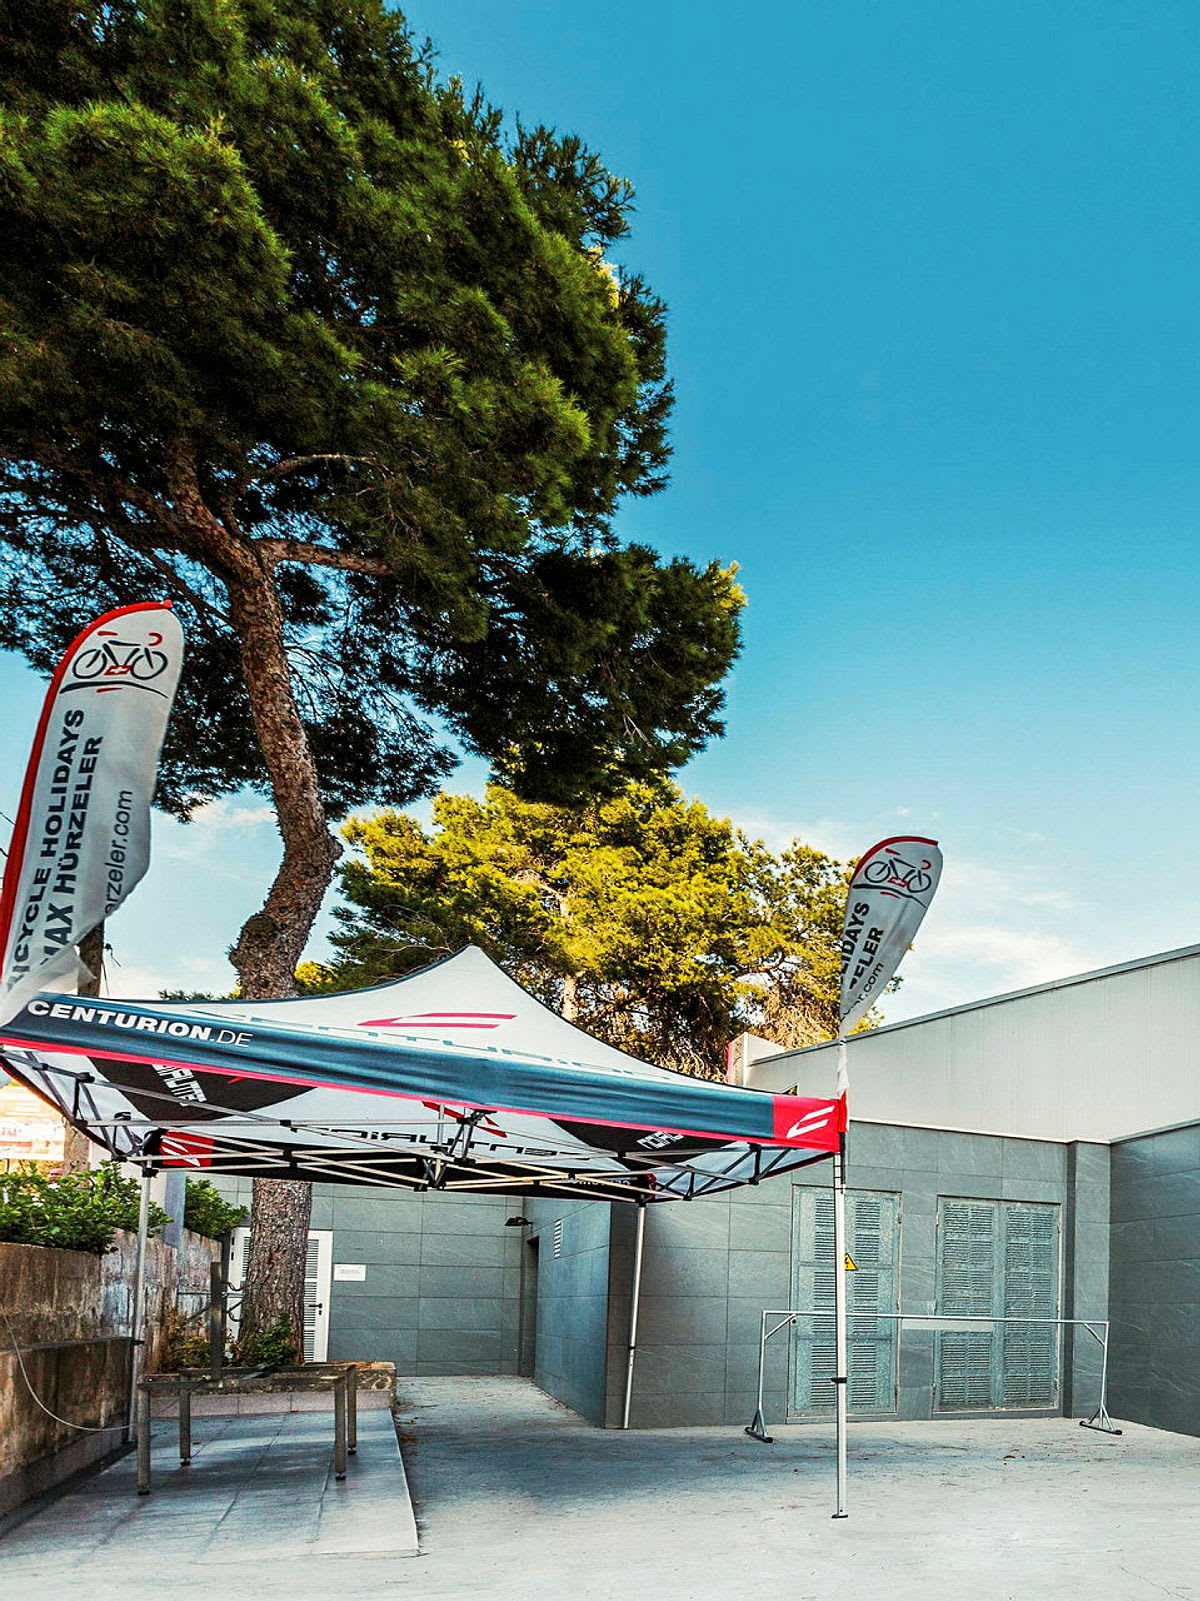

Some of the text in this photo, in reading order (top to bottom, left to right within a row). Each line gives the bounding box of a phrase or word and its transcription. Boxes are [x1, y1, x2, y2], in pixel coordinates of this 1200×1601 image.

[40, 709, 85, 858] HOLIDAYS
[52, 736, 104, 895] HÜRZELER
[27, 1000, 254, 1048] CENTURION.DE
